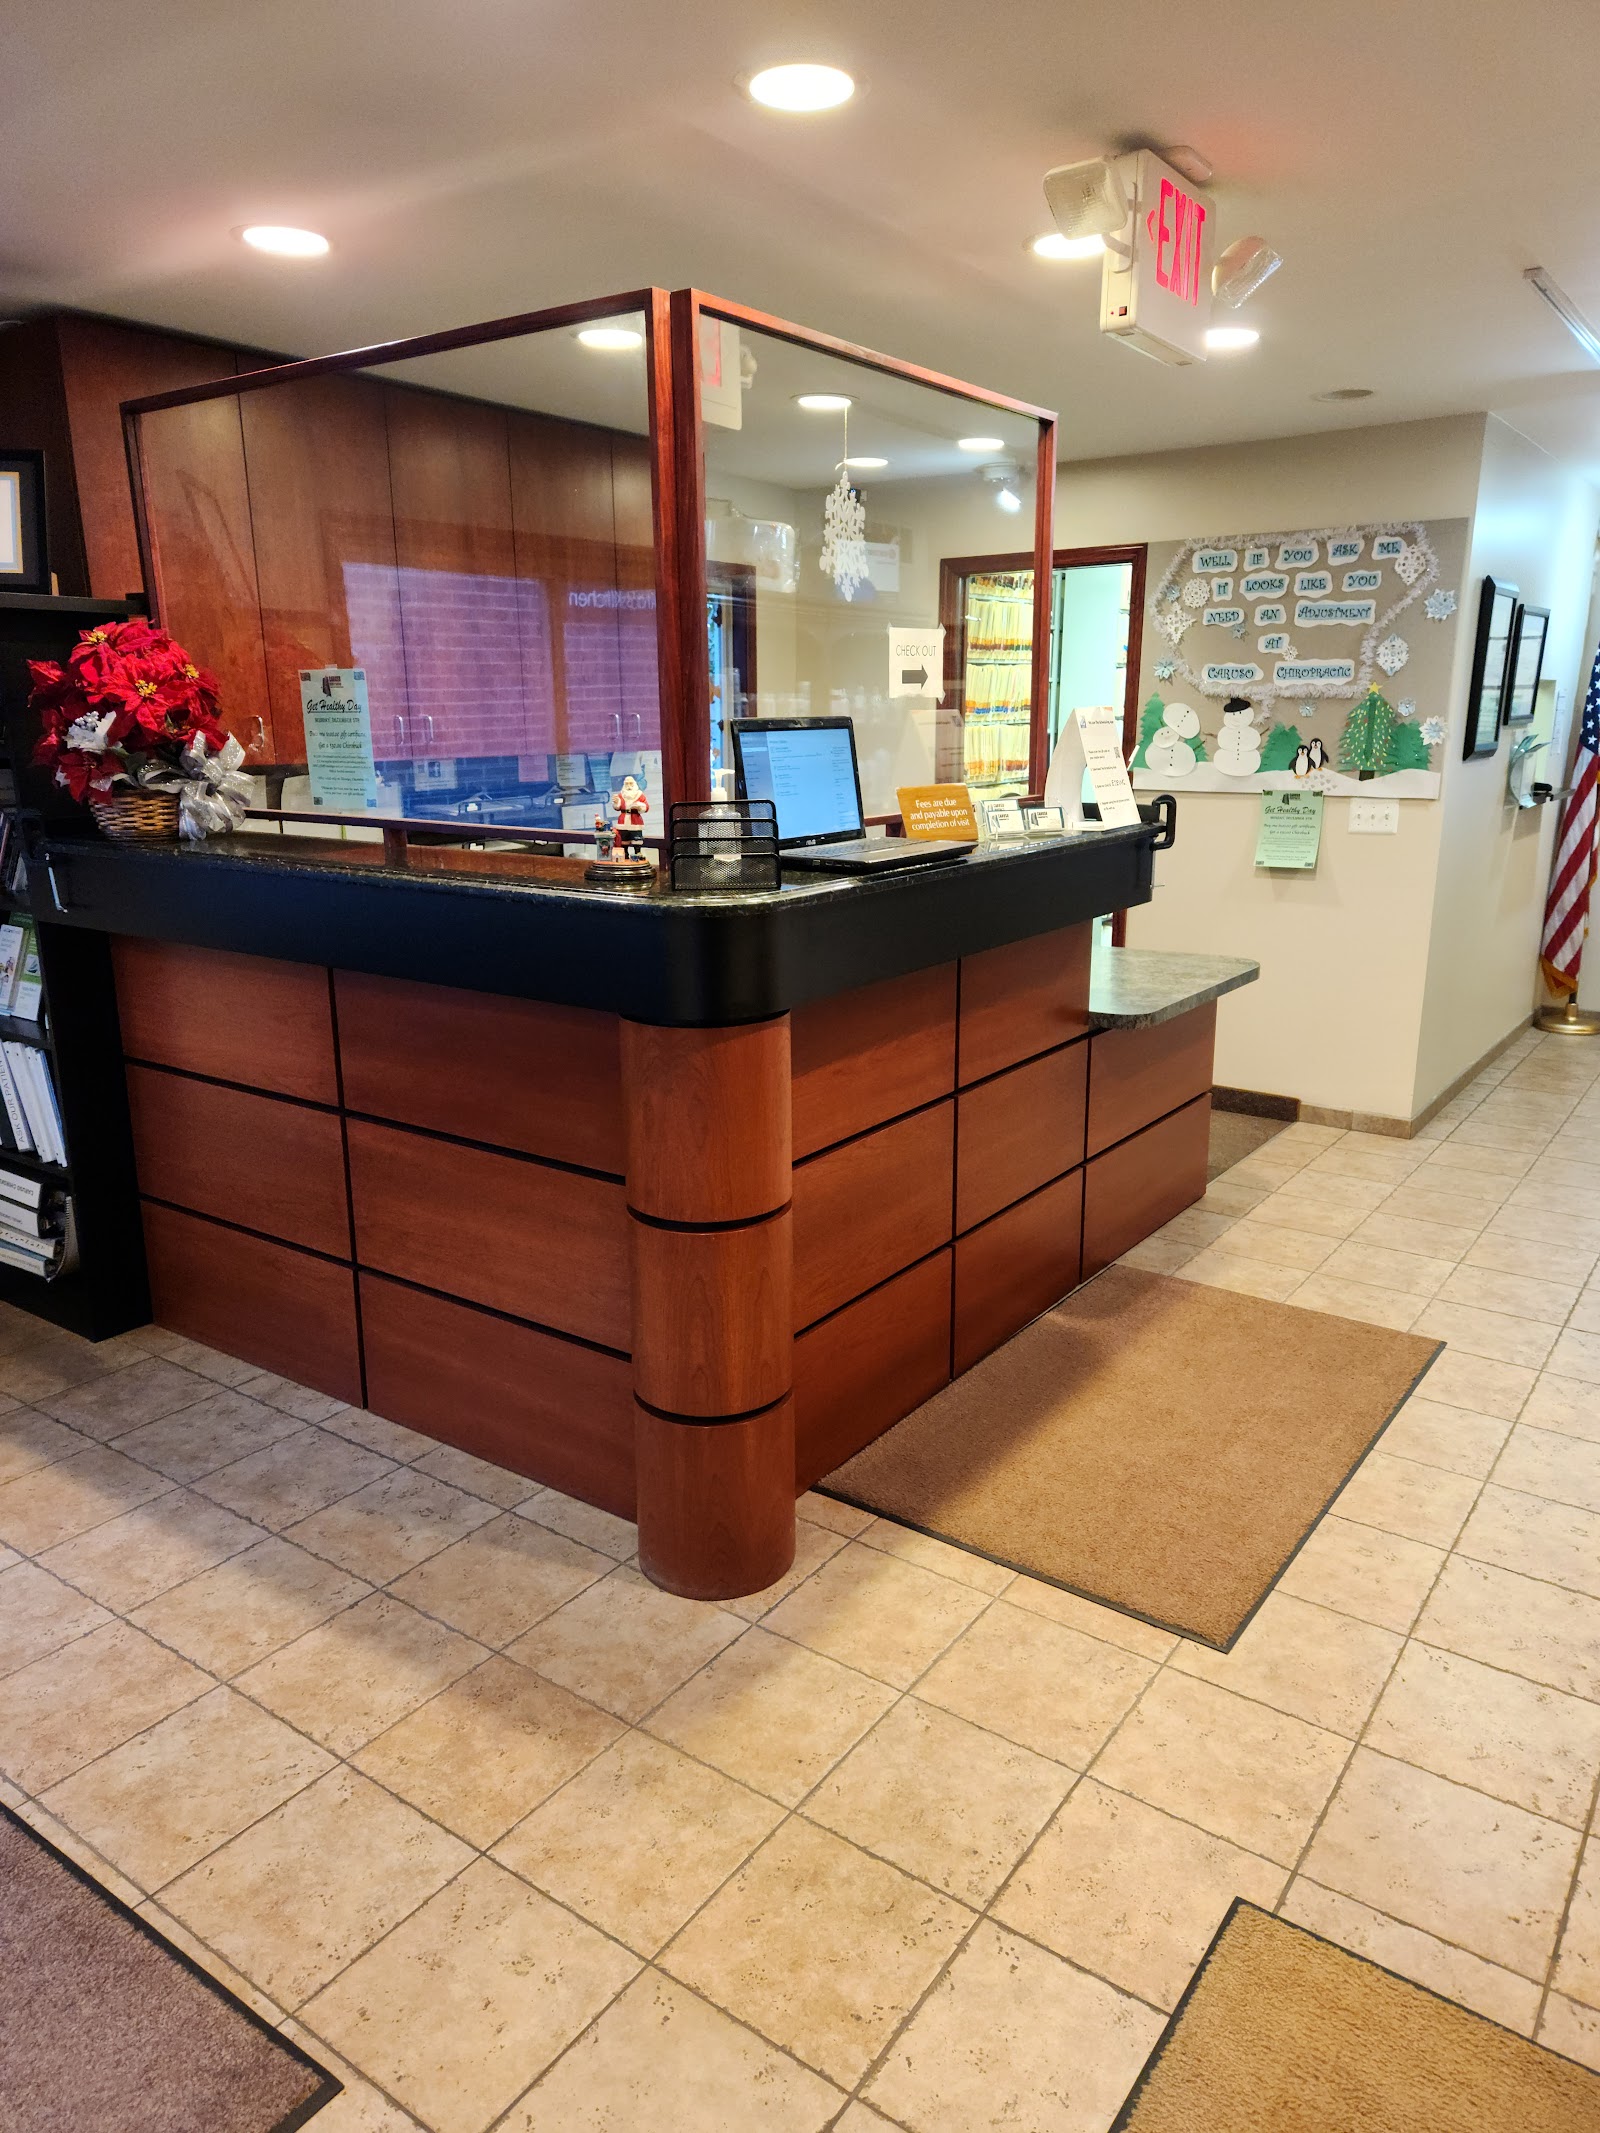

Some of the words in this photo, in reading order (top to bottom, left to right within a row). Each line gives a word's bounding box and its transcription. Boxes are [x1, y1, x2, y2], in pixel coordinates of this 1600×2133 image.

[1155, 177, 1206, 306] EXIT
[1200, 555, 1231, 567] WELL
[1252, 553, 1263, 565] IF
[1283, 549, 1312, 561] YOU
[1332, 544, 1358, 556] ASK
[1378, 541, 1400, 554] ME
[1217, 582, 1228, 595] IT
[1245, 578, 1284, 591] LOOKS
[1300, 578, 1326, 590] LIKE
[1347, 575, 1377, 587] YOU
[1207, 610, 1240, 623] NEED
[1260, 608, 1280, 620] AN
[1298, 606, 1372, 618] ADJUSTMENT
[1265, 636, 1282, 649] AT
[896, 644, 920, 657] CHECK
[922, 644, 937, 657] OUT
[1207, 667, 1254, 680] CARUSO
[1276, 666, 1351, 679] CHIROPRACTIC
[307, 699, 318, 714] Get
[319, 699, 346, 713] Healthy
[346, 699, 362, 714] Day
[915, 799, 932, 809] Fees
[944, 797, 957, 807] due
[910, 809, 924, 820] and
[924, 808, 950, 822] payable
[950, 809, 968, 818] upon
[1264, 806, 1275, 815] Get
[1276, 806, 1300, 815] Healthy
[1302, 806, 1316, 815] Day
[911, 819, 949, 832] completion
[949, 818, 957, 827] of
[956, 818, 970, 827] visit
[7, 1100, 19, 1121] OUR
[13, 1122, 25, 1144] ASK
